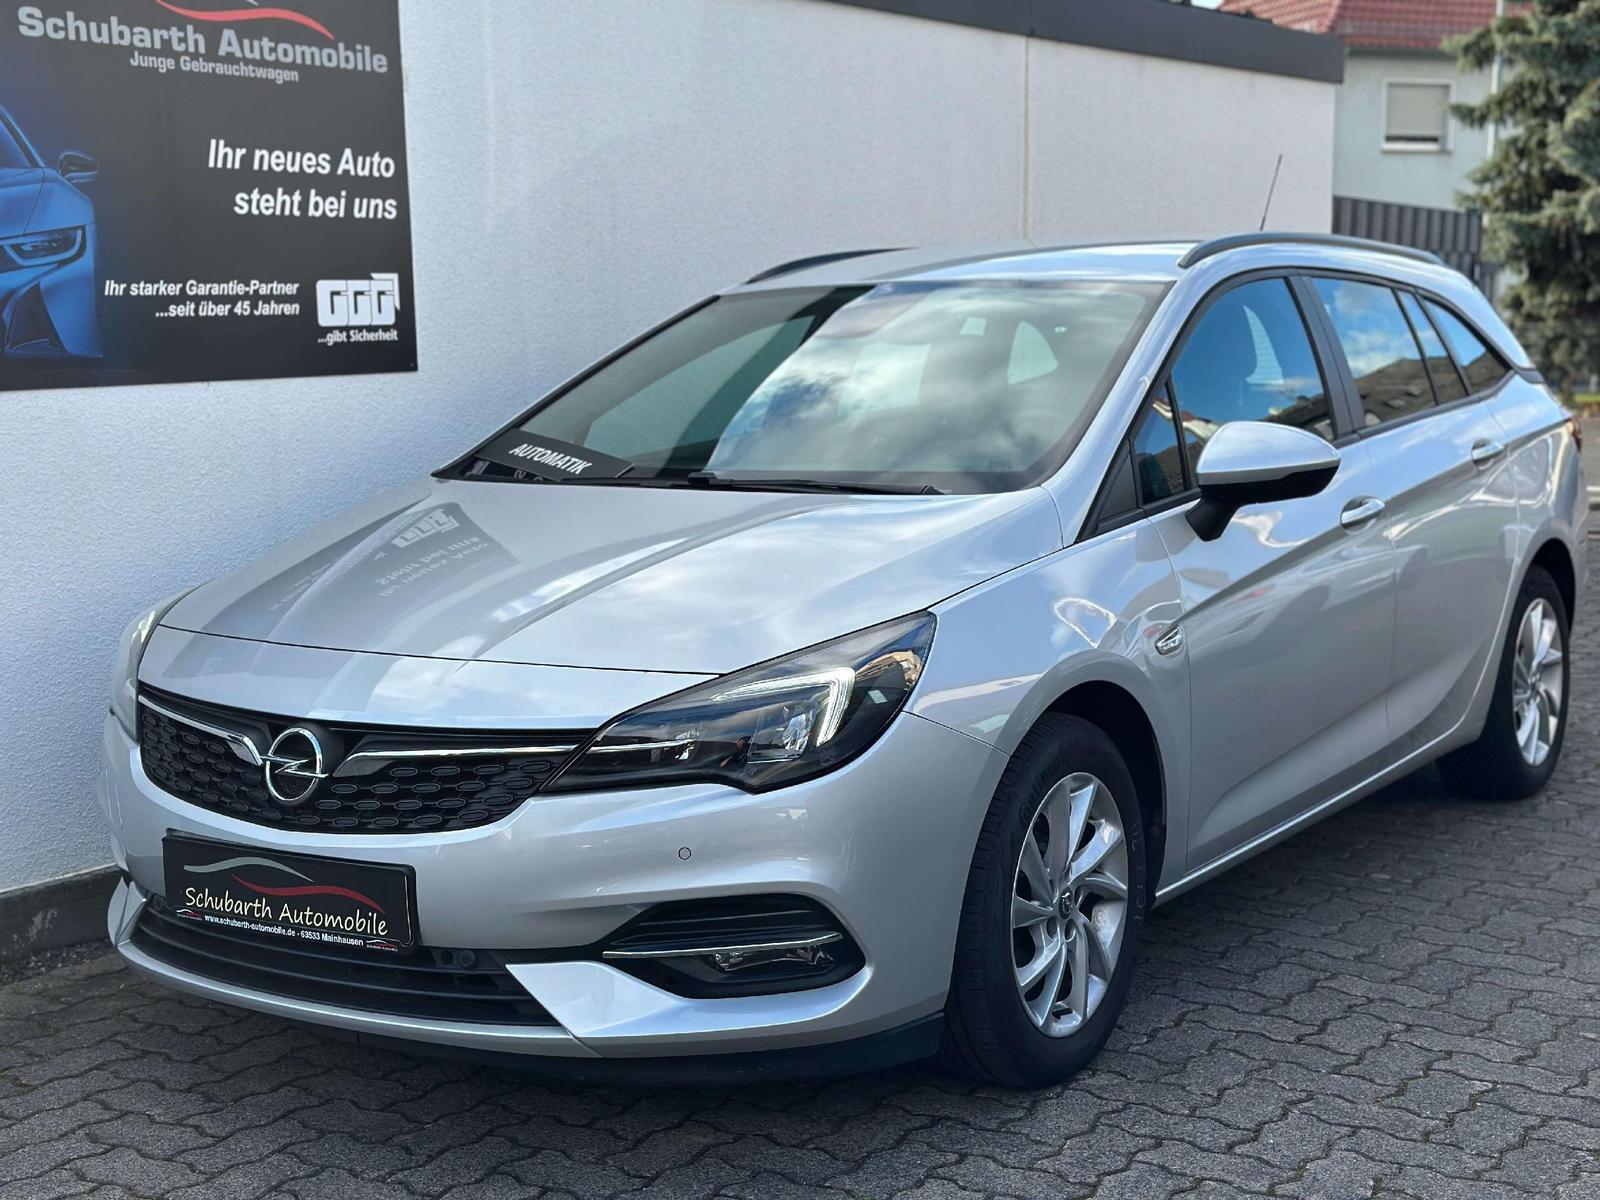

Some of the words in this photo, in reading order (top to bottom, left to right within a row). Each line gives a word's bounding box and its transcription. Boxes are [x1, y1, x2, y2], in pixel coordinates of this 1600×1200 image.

[17, 6, 206, 54] Schubarth
[218, 28, 388, 73] Automobile
[130, 51, 175, 73] Junge
[180, 56, 299, 84] Gebrauchtwagen
[208, 140, 247, 170] Ihr
[253, 149, 332, 175] neues
[336, 147, 396, 178] Auto
[233, 187, 302, 217] steht
[308, 188, 347, 218] bei
[353, 197, 398, 220] uns
[104, 279, 126, 296] Ihr
[129, 280, 183, 296] starker
[185, 279, 300, 296] Garantie-Partner
[199, 300, 231, 316] über
[233, 301, 251, 316] 45
[253, 300, 300, 316] Jahren
[349, 328, 399, 342] Sicherheit
[508, 443, 593, 475] AUTOMATIK
[185, 887, 273, 919] Schubarth
[279, 903, 388, 935] Automobile
[204, 914, 296, 937] www.schubarth-automobile.de
[300, 930, 321, 941] 63533
[321, 932, 364, 946] Mainhausen
